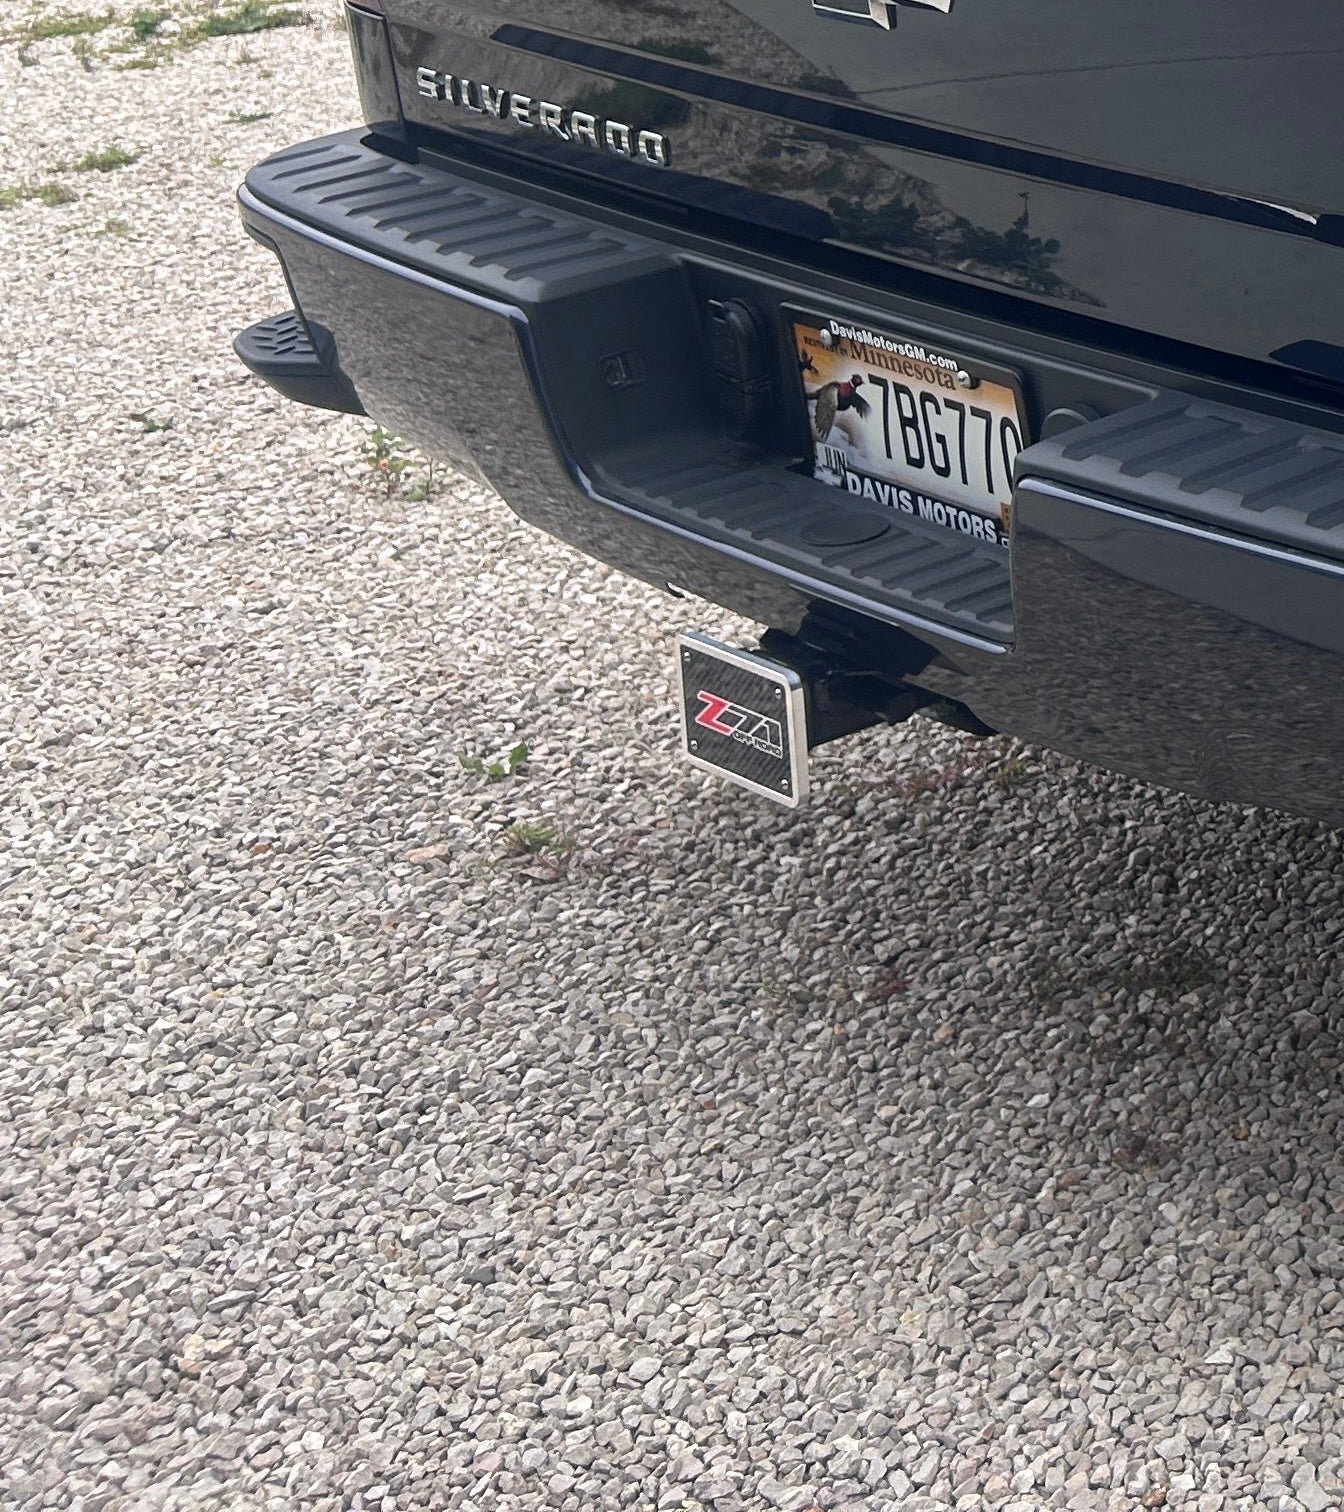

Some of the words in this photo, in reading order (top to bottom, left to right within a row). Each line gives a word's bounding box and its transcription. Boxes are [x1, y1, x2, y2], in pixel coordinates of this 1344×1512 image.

[416, 66, 667, 168] SILVERADO
[829, 319, 959, 372] DavisMotorsGM.com
[850, 342, 956, 391] Minnesota
[846, 471, 914, 515] DAVIS
[917, 495, 998, 544] MOTORS
[694, 690, 782, 747] Z71
